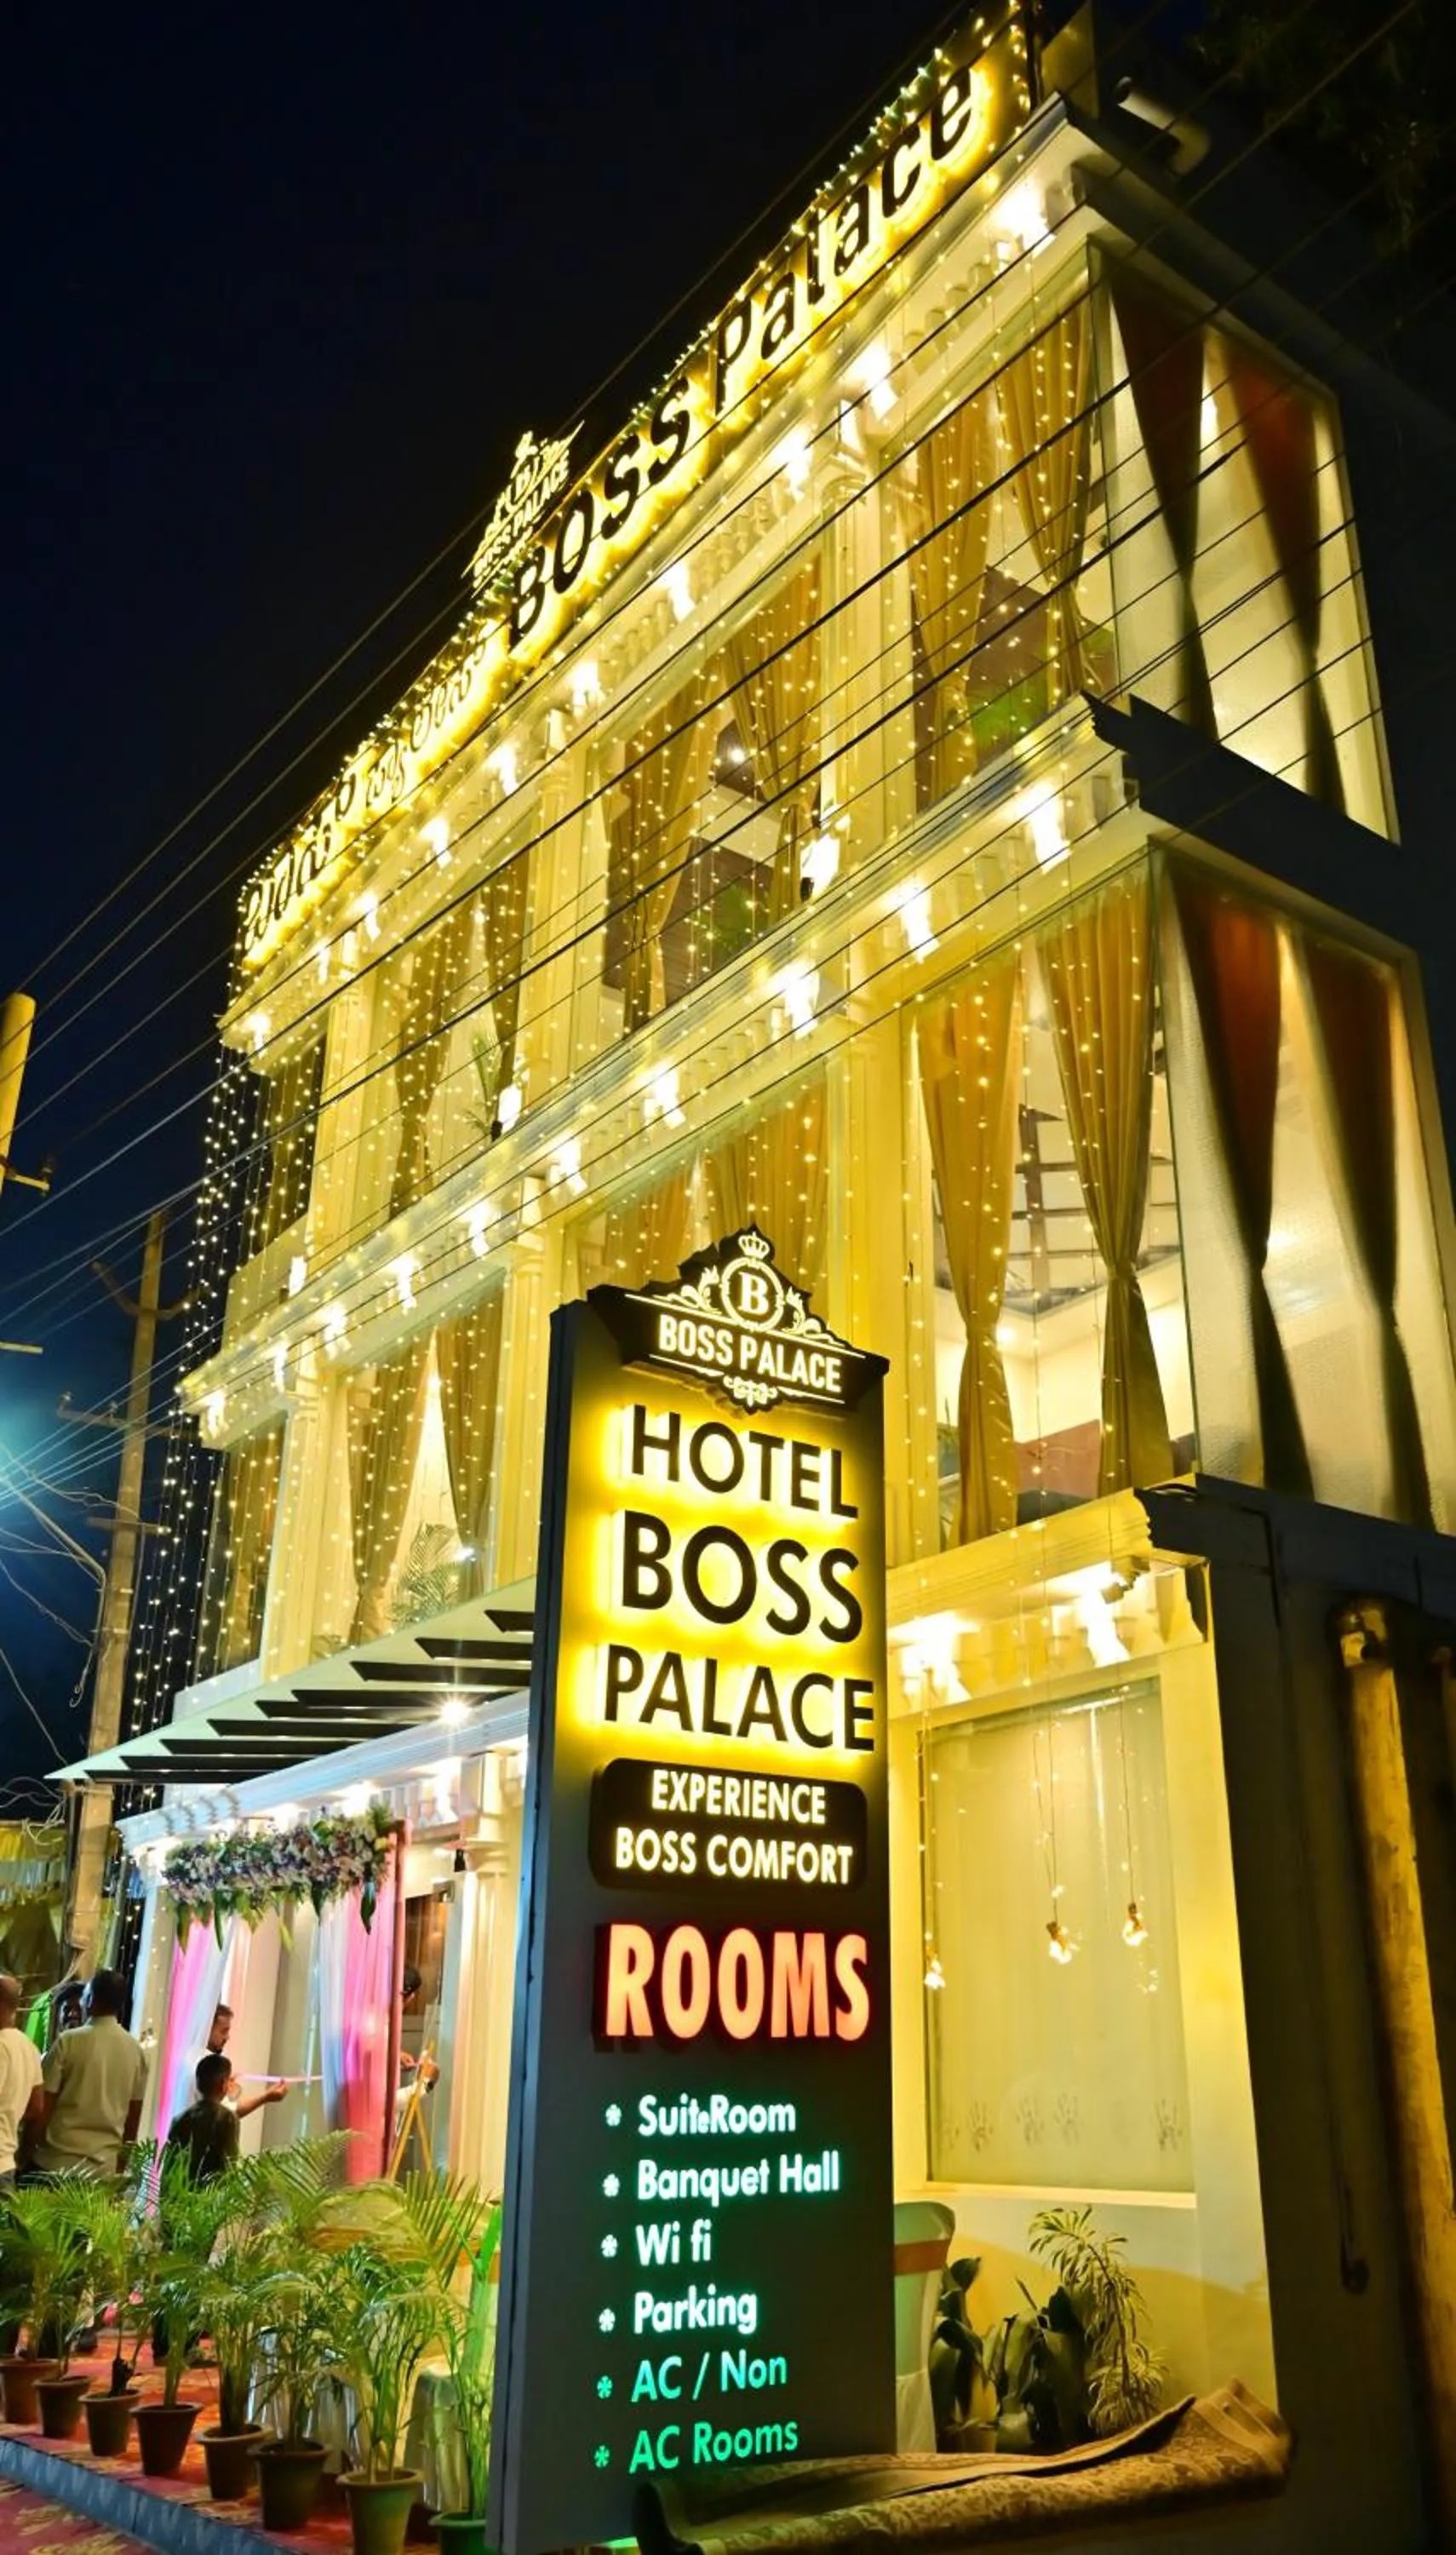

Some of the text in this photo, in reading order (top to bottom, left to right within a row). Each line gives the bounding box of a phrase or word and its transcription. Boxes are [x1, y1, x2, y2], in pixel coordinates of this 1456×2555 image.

[509, 65, 972, 644] BOSS Palace
[741, 1271, 768, 1316] B
[658, 1312, 842, 1393] BOSS PALACE
[630, 1404, 860, 1519] HOTEL
[622, 1509, 863, 1645] BOSS
[604, 1645, 875, 1753] PALACE
[651, 1769, 827, 1826] EXPERIENCE
[616, 1827, 854, 1886] BOSS COMFORT
[605, 1923, 869, 2041] ROOMS
[637, 2150, 840, 2206] Banquet Hall
[635, 2218, 712, 2265] Wi fi
[633, 2284, 758, 2334] Parking
[631, 2356, 682, 2403] AC
[720, 2349, 787, 2392] Non
[629, 2420, 799, 2473] AC Rooms
